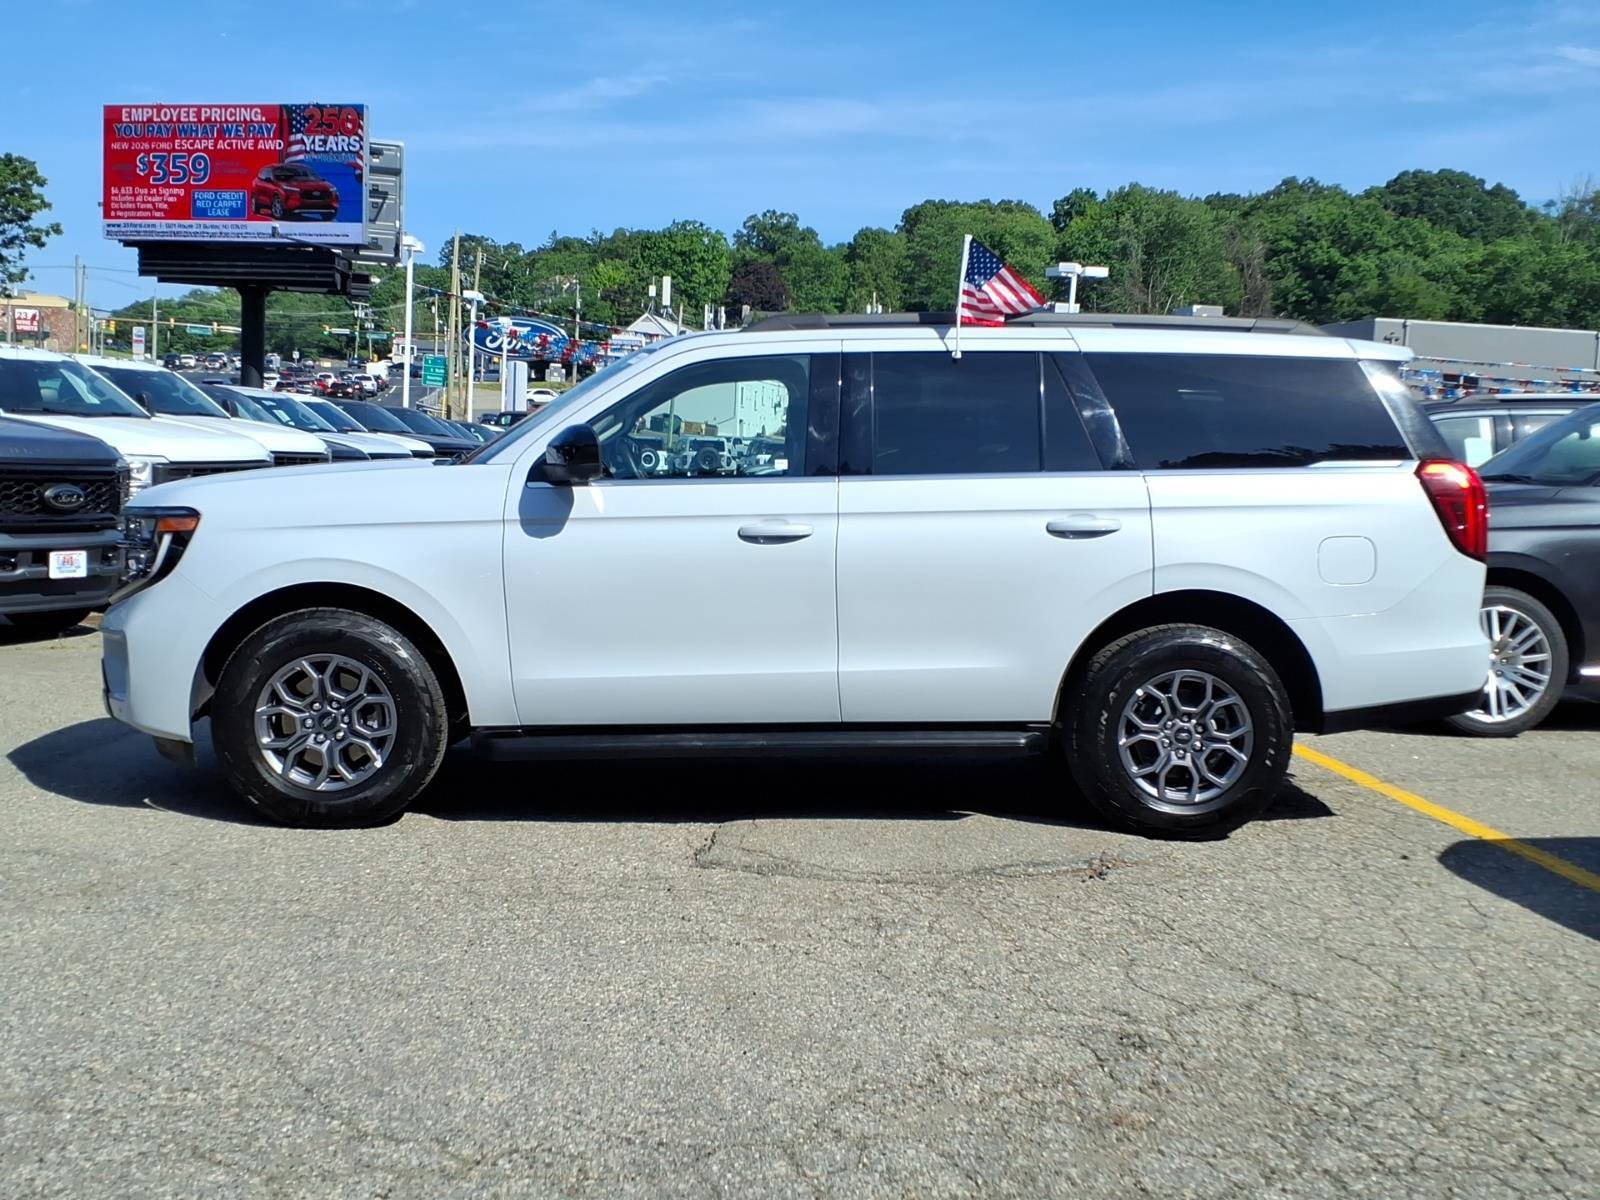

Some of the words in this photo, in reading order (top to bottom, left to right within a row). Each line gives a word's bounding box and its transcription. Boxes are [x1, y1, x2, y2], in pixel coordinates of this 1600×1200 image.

[121, 108, 198, 121] EMPLOYEE
[303, 107, 359, 136] 250
[113, 123, 143, 138] YOU
[146, 124, 173, 138] PAY
[176, 124, 219, 138] WHAT
[223, 124, 245, 138] WE
[247, 124, 276, 138] PAY
[111, 142, 129, 150] NEW
[131, 142, 150, 150] 2026
[151, 142, 173, 150] FORD
[174, 139, 214, 150] ESCAPE
[217, 140, 254, 150] ACTIVE
[257, 140, 284, 150] AWD
[302, 135, 361, 152] YEARS
[136, 152, 211, 185] $359
[134, 186, 148, 195] Due
[149, 187, 157, 195] at
[158, 186, 185, 197] Signing
[194, 191, 215, 200] FORD
[217, 191, 244, 200] CREDIT
[143, 194, 163, 202] Dealer
[196, 199, 212, 208] RED
[213, 199, 242, 208] CARPET
[116, 210, 151, 218] Registration
[207, 208, 230, 216] LEASE
